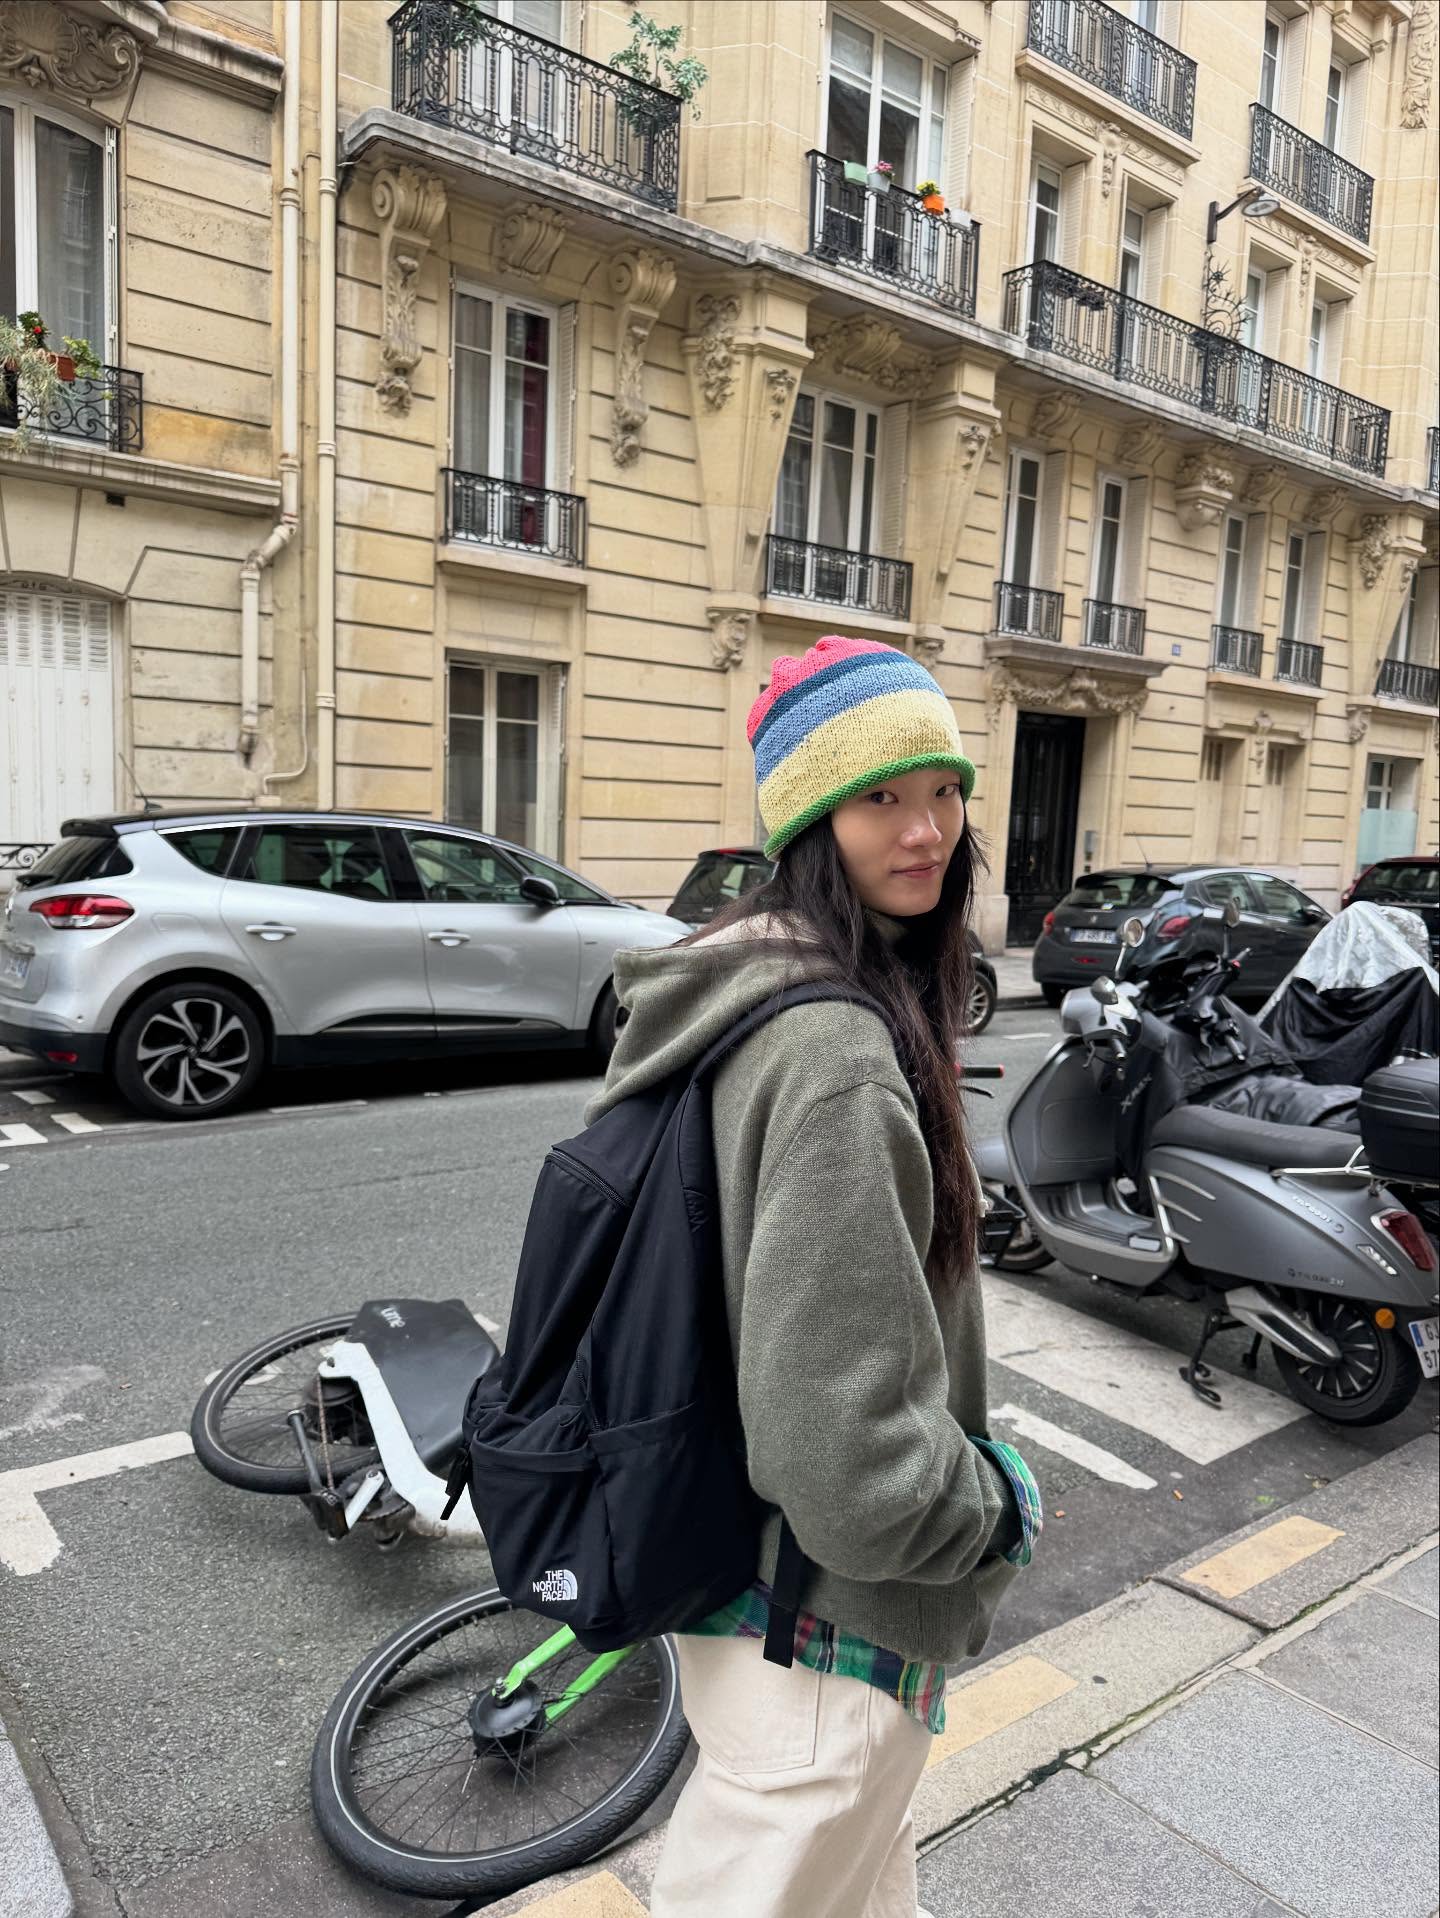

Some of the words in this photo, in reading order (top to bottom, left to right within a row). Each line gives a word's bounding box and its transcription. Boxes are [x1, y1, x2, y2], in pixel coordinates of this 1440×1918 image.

[1423, 1349, 1439, 1368] 57
[545, 1570, 563, 1580] THE
[533, 1581, 563, 1592] NORTH
[542, 1591, 563, 1602] FACE
